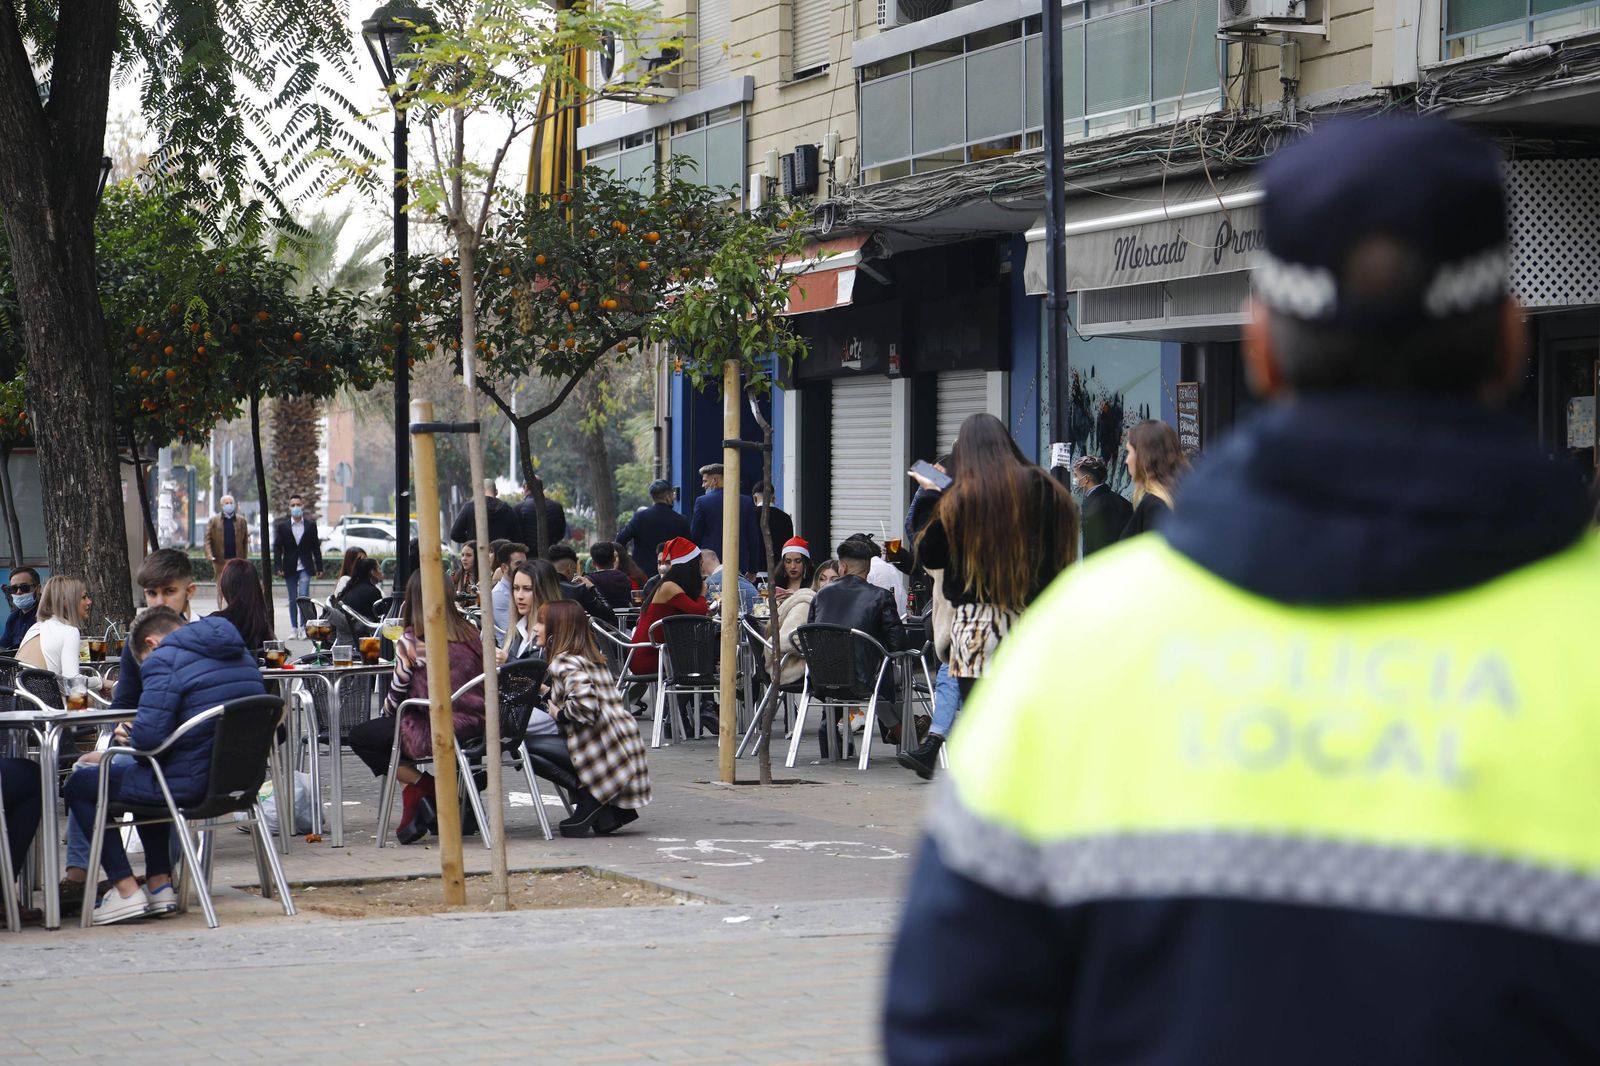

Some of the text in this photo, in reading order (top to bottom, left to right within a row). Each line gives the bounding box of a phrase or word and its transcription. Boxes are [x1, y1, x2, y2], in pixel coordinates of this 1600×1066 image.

[1114, 220, 1266, 271] Mercado Prove
[1156, 631, 1521, 717] POLICIA
[1181, 704, 1478, 792] LOCAL
